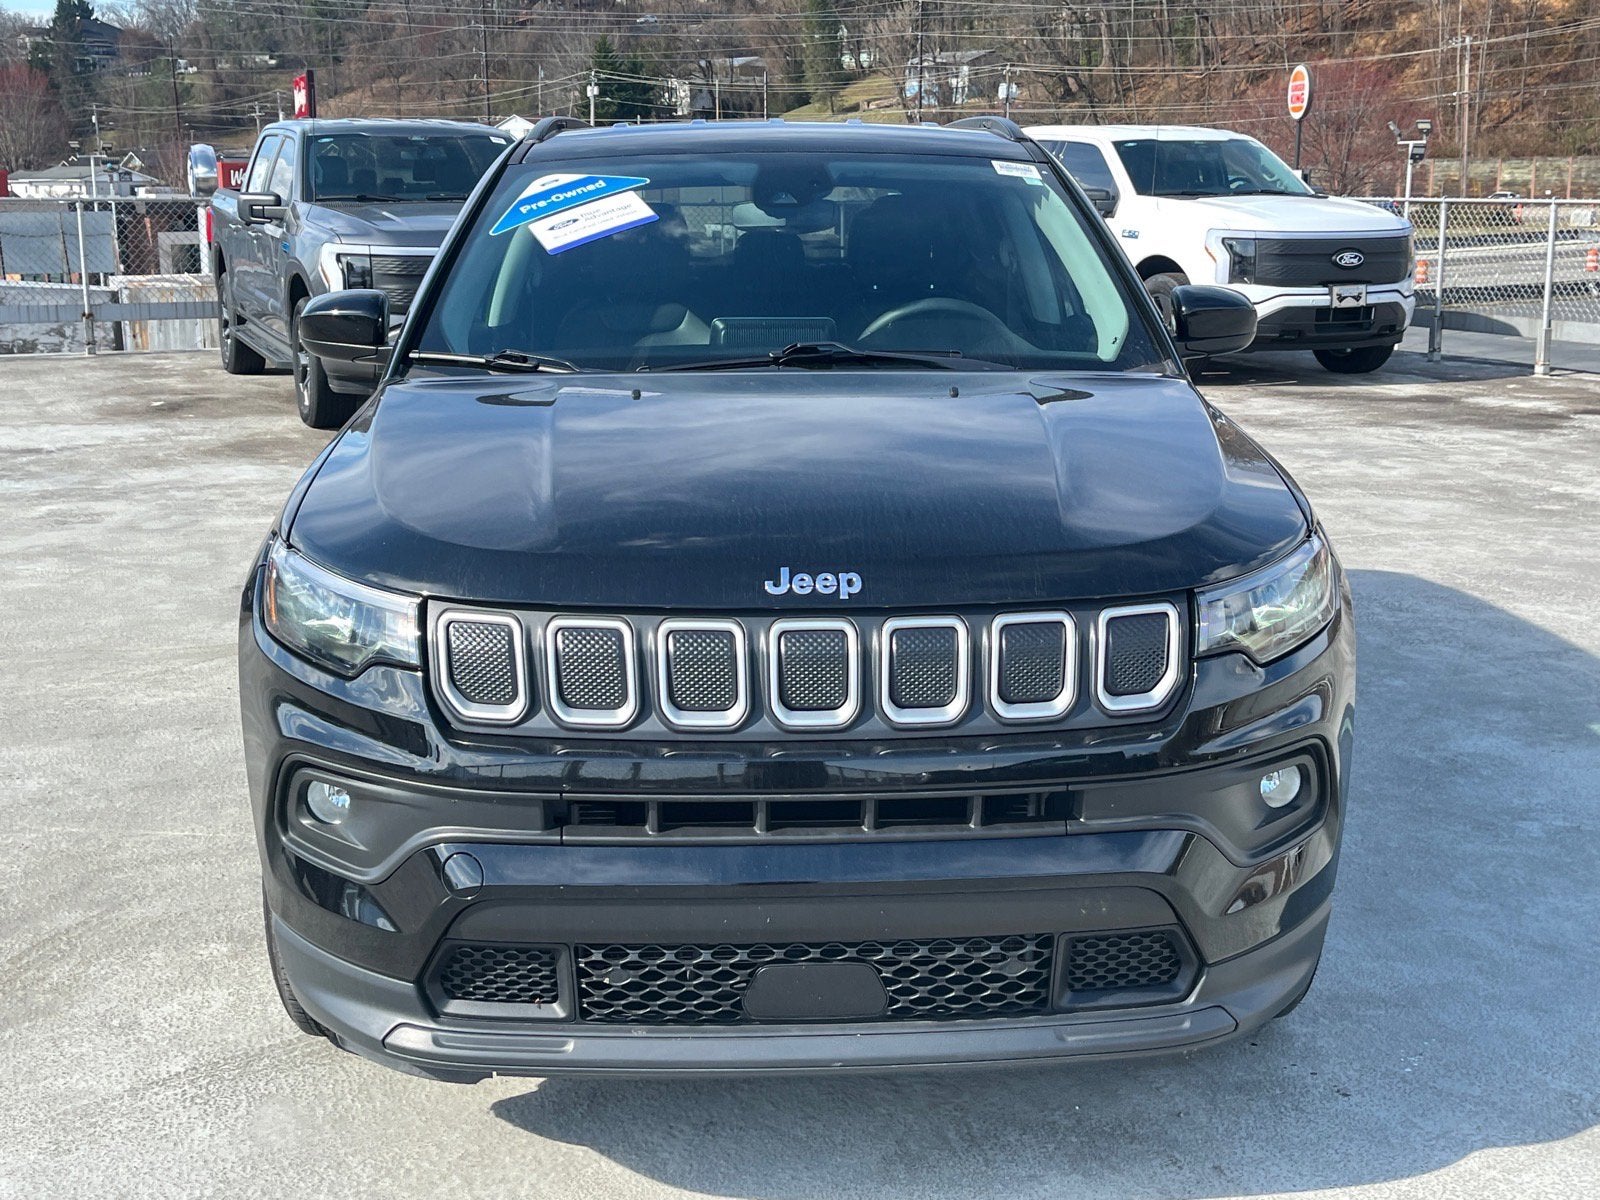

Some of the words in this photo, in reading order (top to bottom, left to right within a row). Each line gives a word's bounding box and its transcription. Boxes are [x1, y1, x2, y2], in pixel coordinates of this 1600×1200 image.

[1290, 92, 1305, 105] KING
[519, 179, 607, 214] Pre-Owned
[764, 566, 862, 600] Jeep
